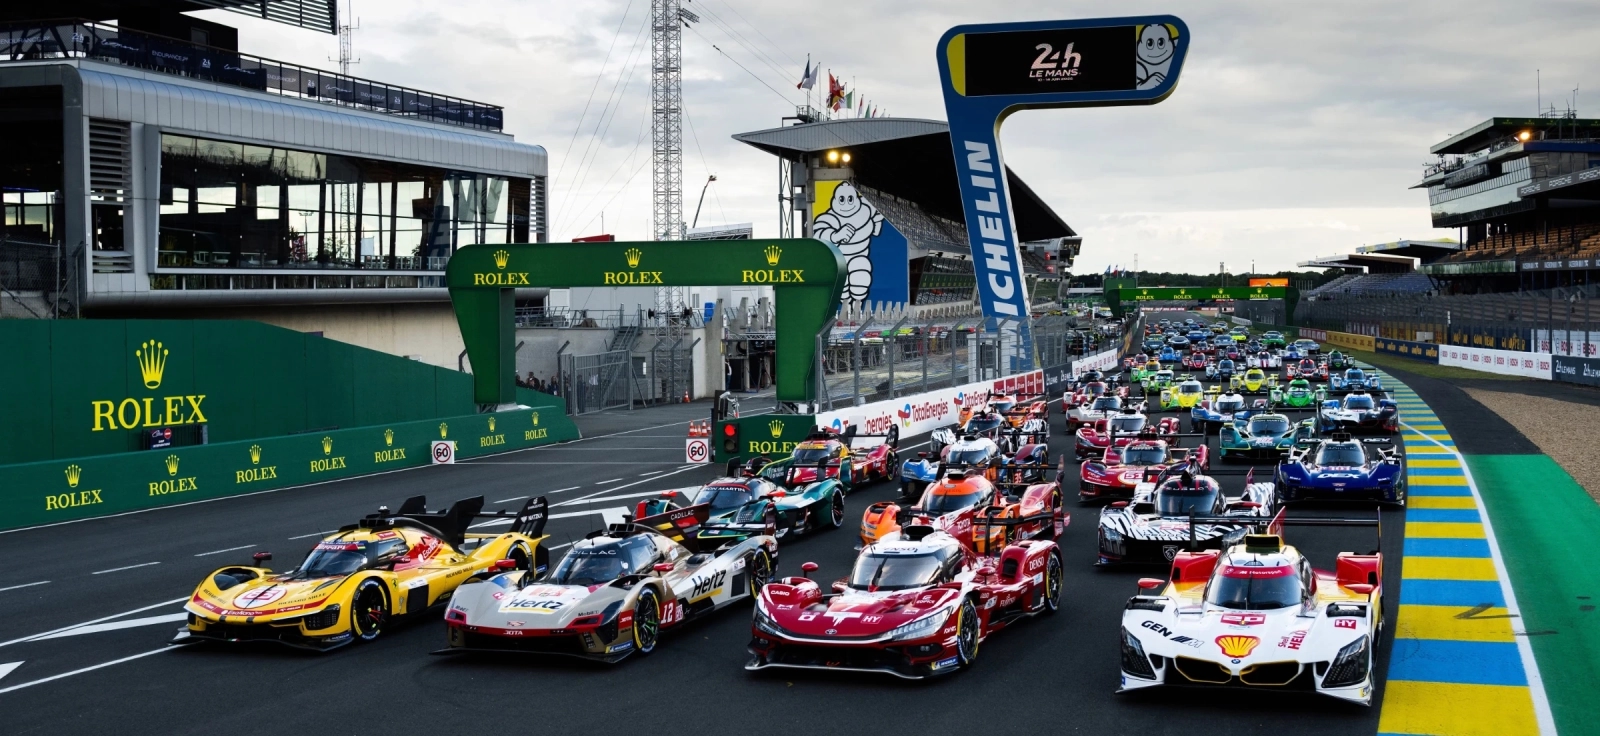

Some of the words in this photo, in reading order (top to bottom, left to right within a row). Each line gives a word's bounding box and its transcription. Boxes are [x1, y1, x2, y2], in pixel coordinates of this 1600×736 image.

[1031, 42, 1081, 69] 24h
[1549, 176, 1572, 187] PORSCHE
[1521, 184, 1540, 194] PORSCHE
[474, 273, 530, 285] ROLEX
[604, 271, 663, 284] ROLEX
[742, 270, 805, 283] ROLEX
[1583, 343, 1596, 355] BSCH
[1525, 360, 1533, 368] BOSCH
[1540, 362, 1550, 370] BOSCH
[92, 395, 207, 431] ROLEX
[912, 400, 948, 422] TotalEnergies
[480, 434, 505, 447] ROLEX
[525, 428, 548, 440] ROLEX
[374, 448, 406, 463] ROLEX
[436, 448, 448, 457] 60
[691, 446, 704, 456] 60
[310, 456, 346, 472] ROLEX
[236, 466, 277, 483] ROLEX
[149, 477, 198, 496] ROLEX
[46, 489, 103, 510] ROLEX
[671, 510, 694, 520] CADILLAC
[1029, 557, 1044, 570] DENSO
[691, 569, 727, 598] Hertz
[505, 599, 566, 609] Hertz
[660, 603, 674, 624] 12
[1141, 620, 1172, 637] GEN
[1278, 636, 1290, 648] Shell
